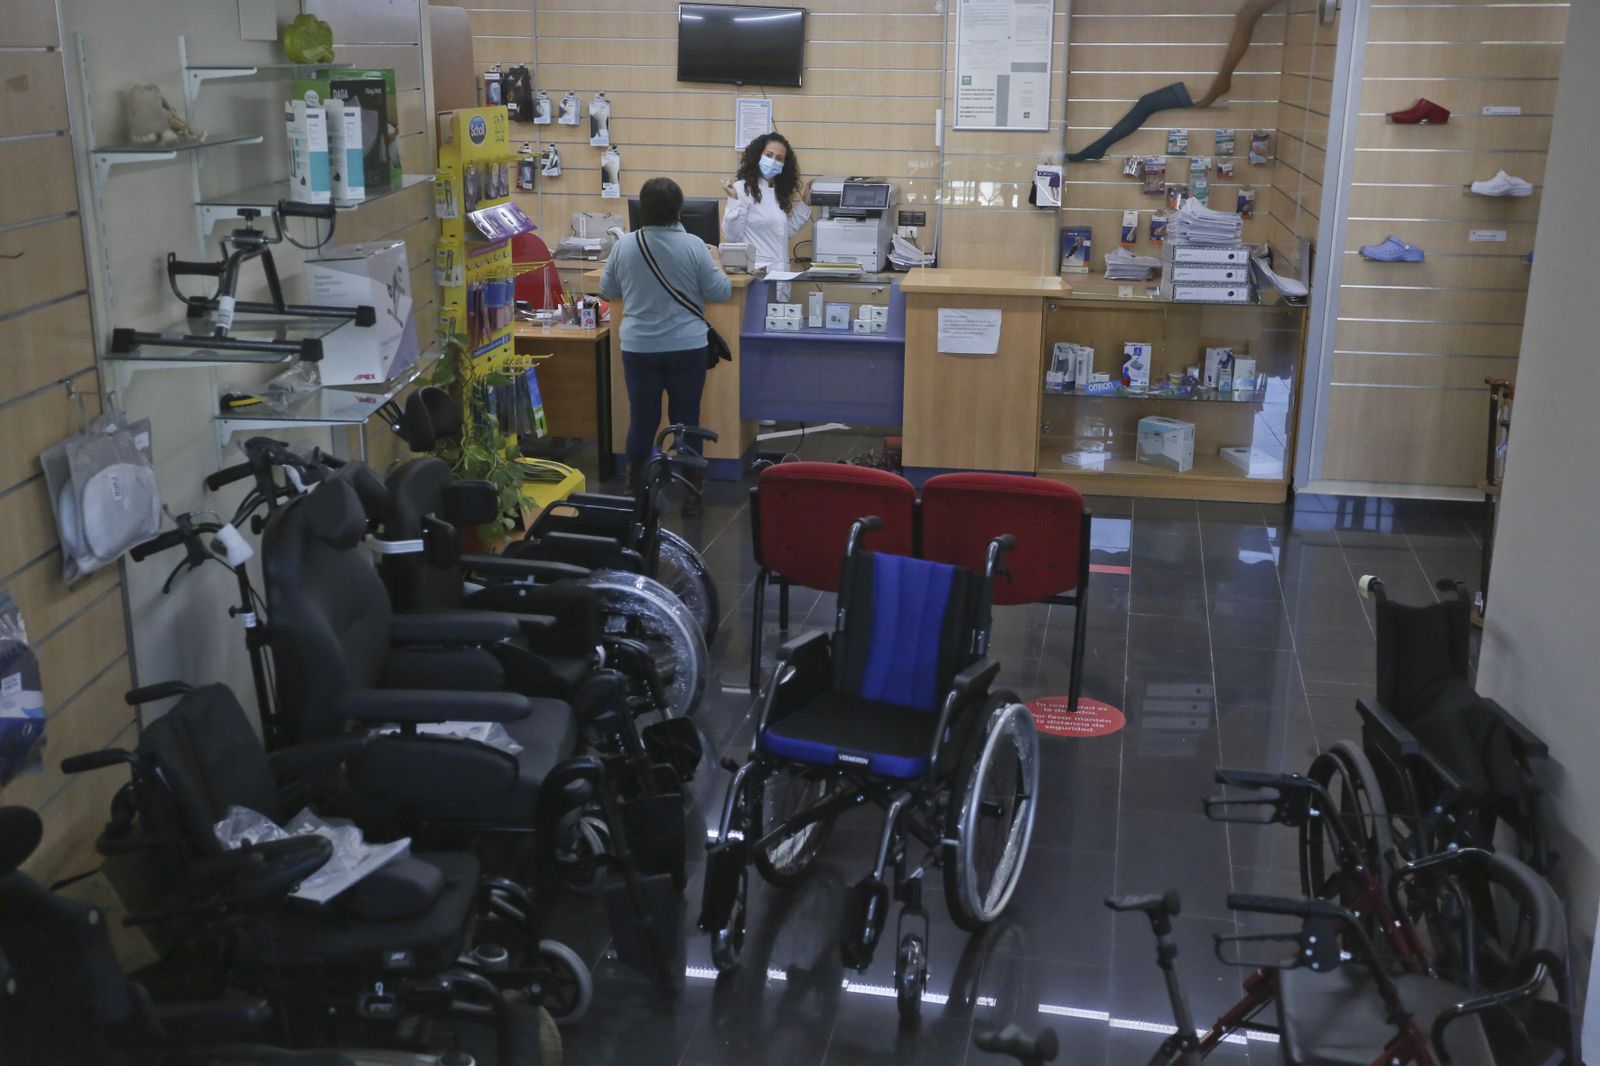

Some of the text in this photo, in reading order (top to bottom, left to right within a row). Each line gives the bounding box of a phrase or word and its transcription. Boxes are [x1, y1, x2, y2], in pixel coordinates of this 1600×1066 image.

[470, 122, 486, 137] Scholl
[1046, 719, 1090, 727] distancia
[1045, 725, 1096, 733] seguridad.
